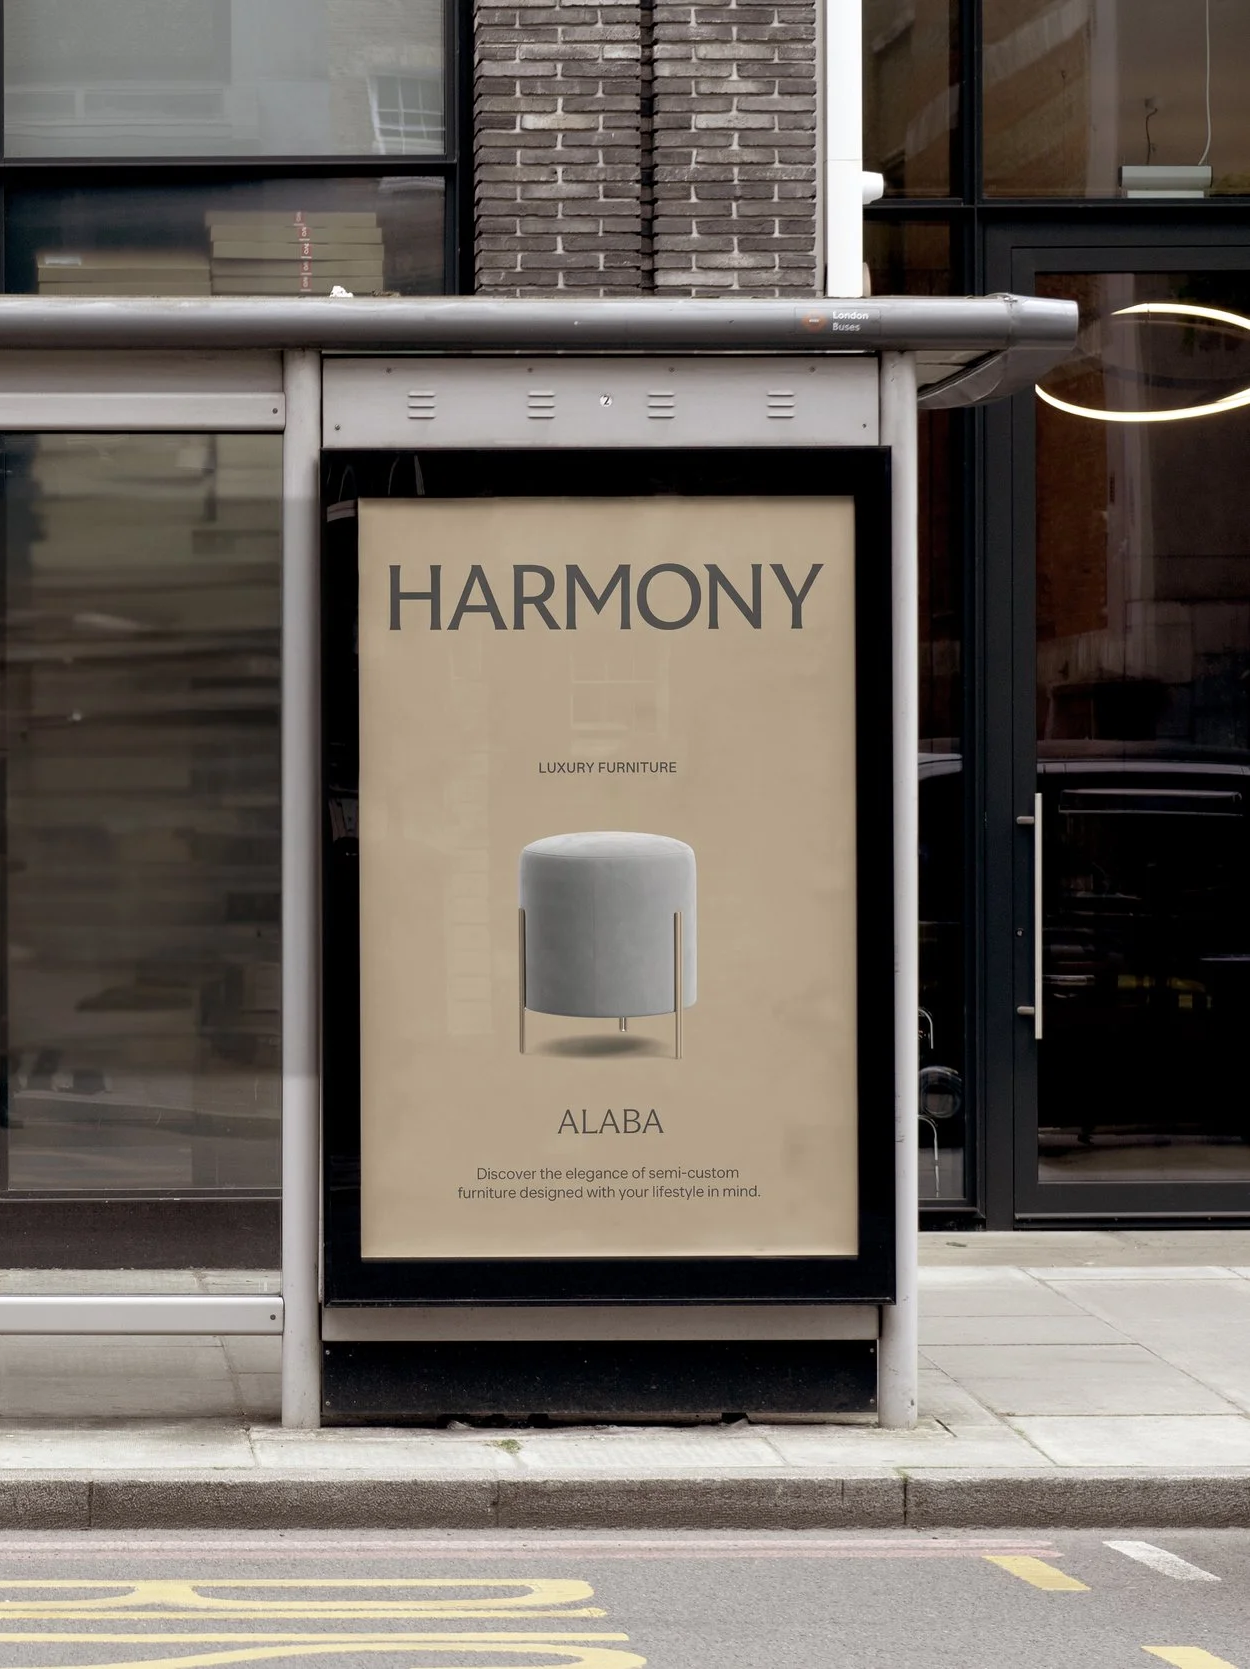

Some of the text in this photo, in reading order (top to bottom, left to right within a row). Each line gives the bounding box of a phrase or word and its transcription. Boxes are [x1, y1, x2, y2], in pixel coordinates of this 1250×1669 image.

[832, 310, 869, 320] London
[832, 322, 861, 332] Buses
[389, 562, 824, 630] HARMONY
[538, 762, 677, 774] LUXURY FURNITURE
[557, 1108, 665, 1135] ALABA
[476, 1167, 740, 1183] Discover the elegance of semi-custom
[457, 1184, 761, 1202] furniture designed with your lifestyle in mind.
